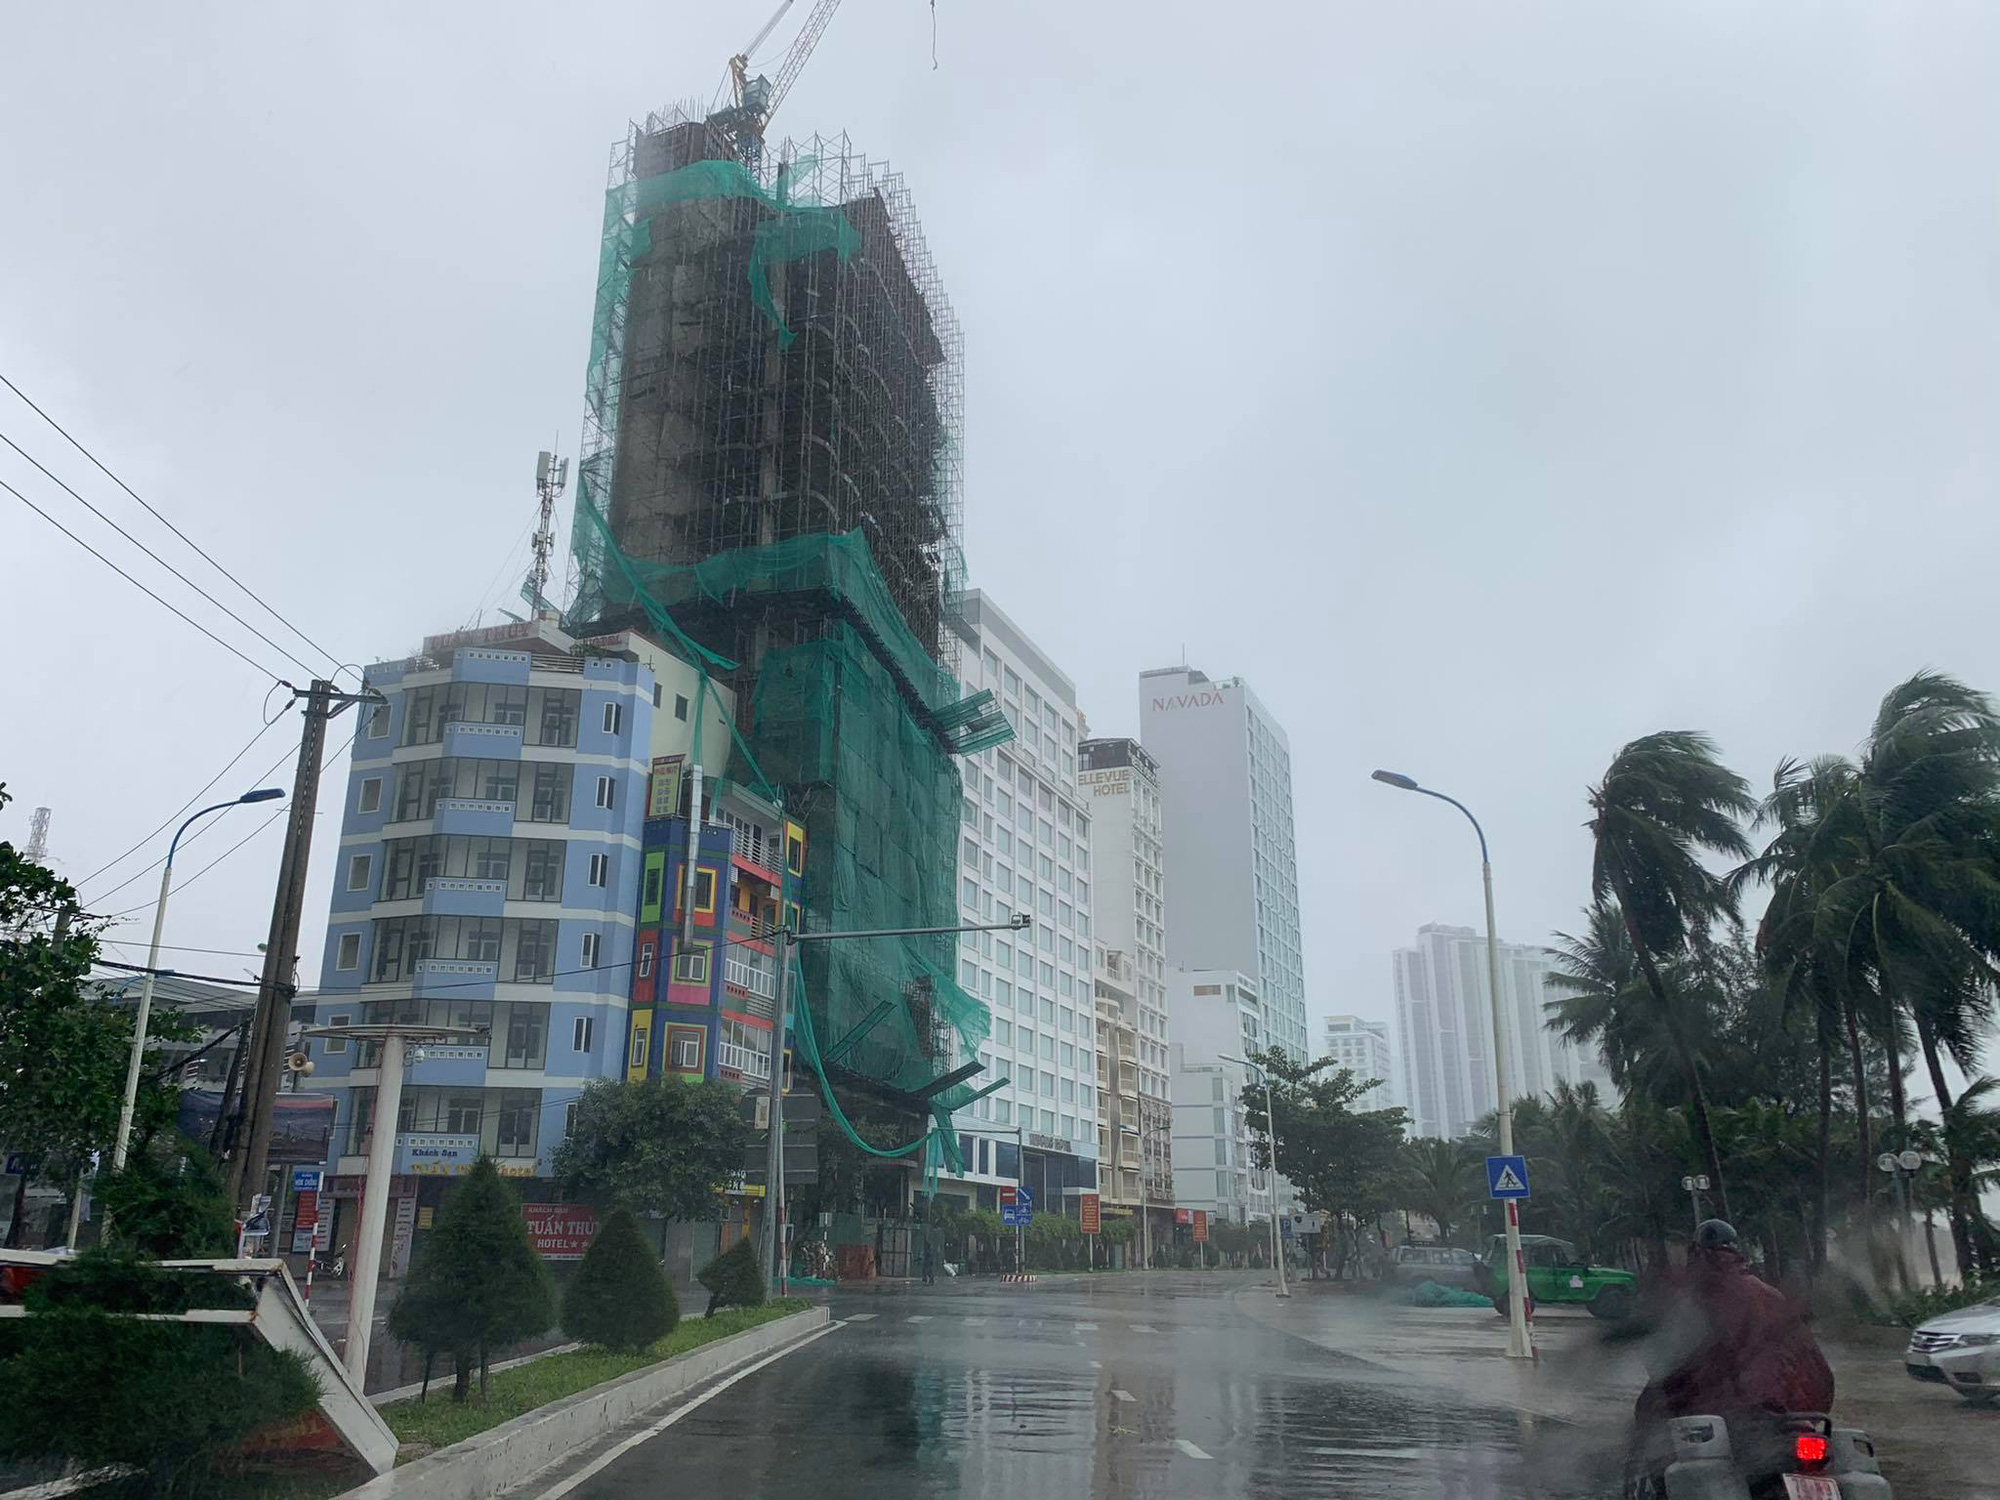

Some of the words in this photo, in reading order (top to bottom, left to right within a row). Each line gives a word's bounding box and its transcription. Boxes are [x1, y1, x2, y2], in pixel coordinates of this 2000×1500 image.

[1152, 691, 1224, 711] NAVADA
[1093, 783, 1130, 797] HOTEL
[526, 1214, 564, 1235] TUẤN
[537, 1239, 569, 1249] HOTEL
